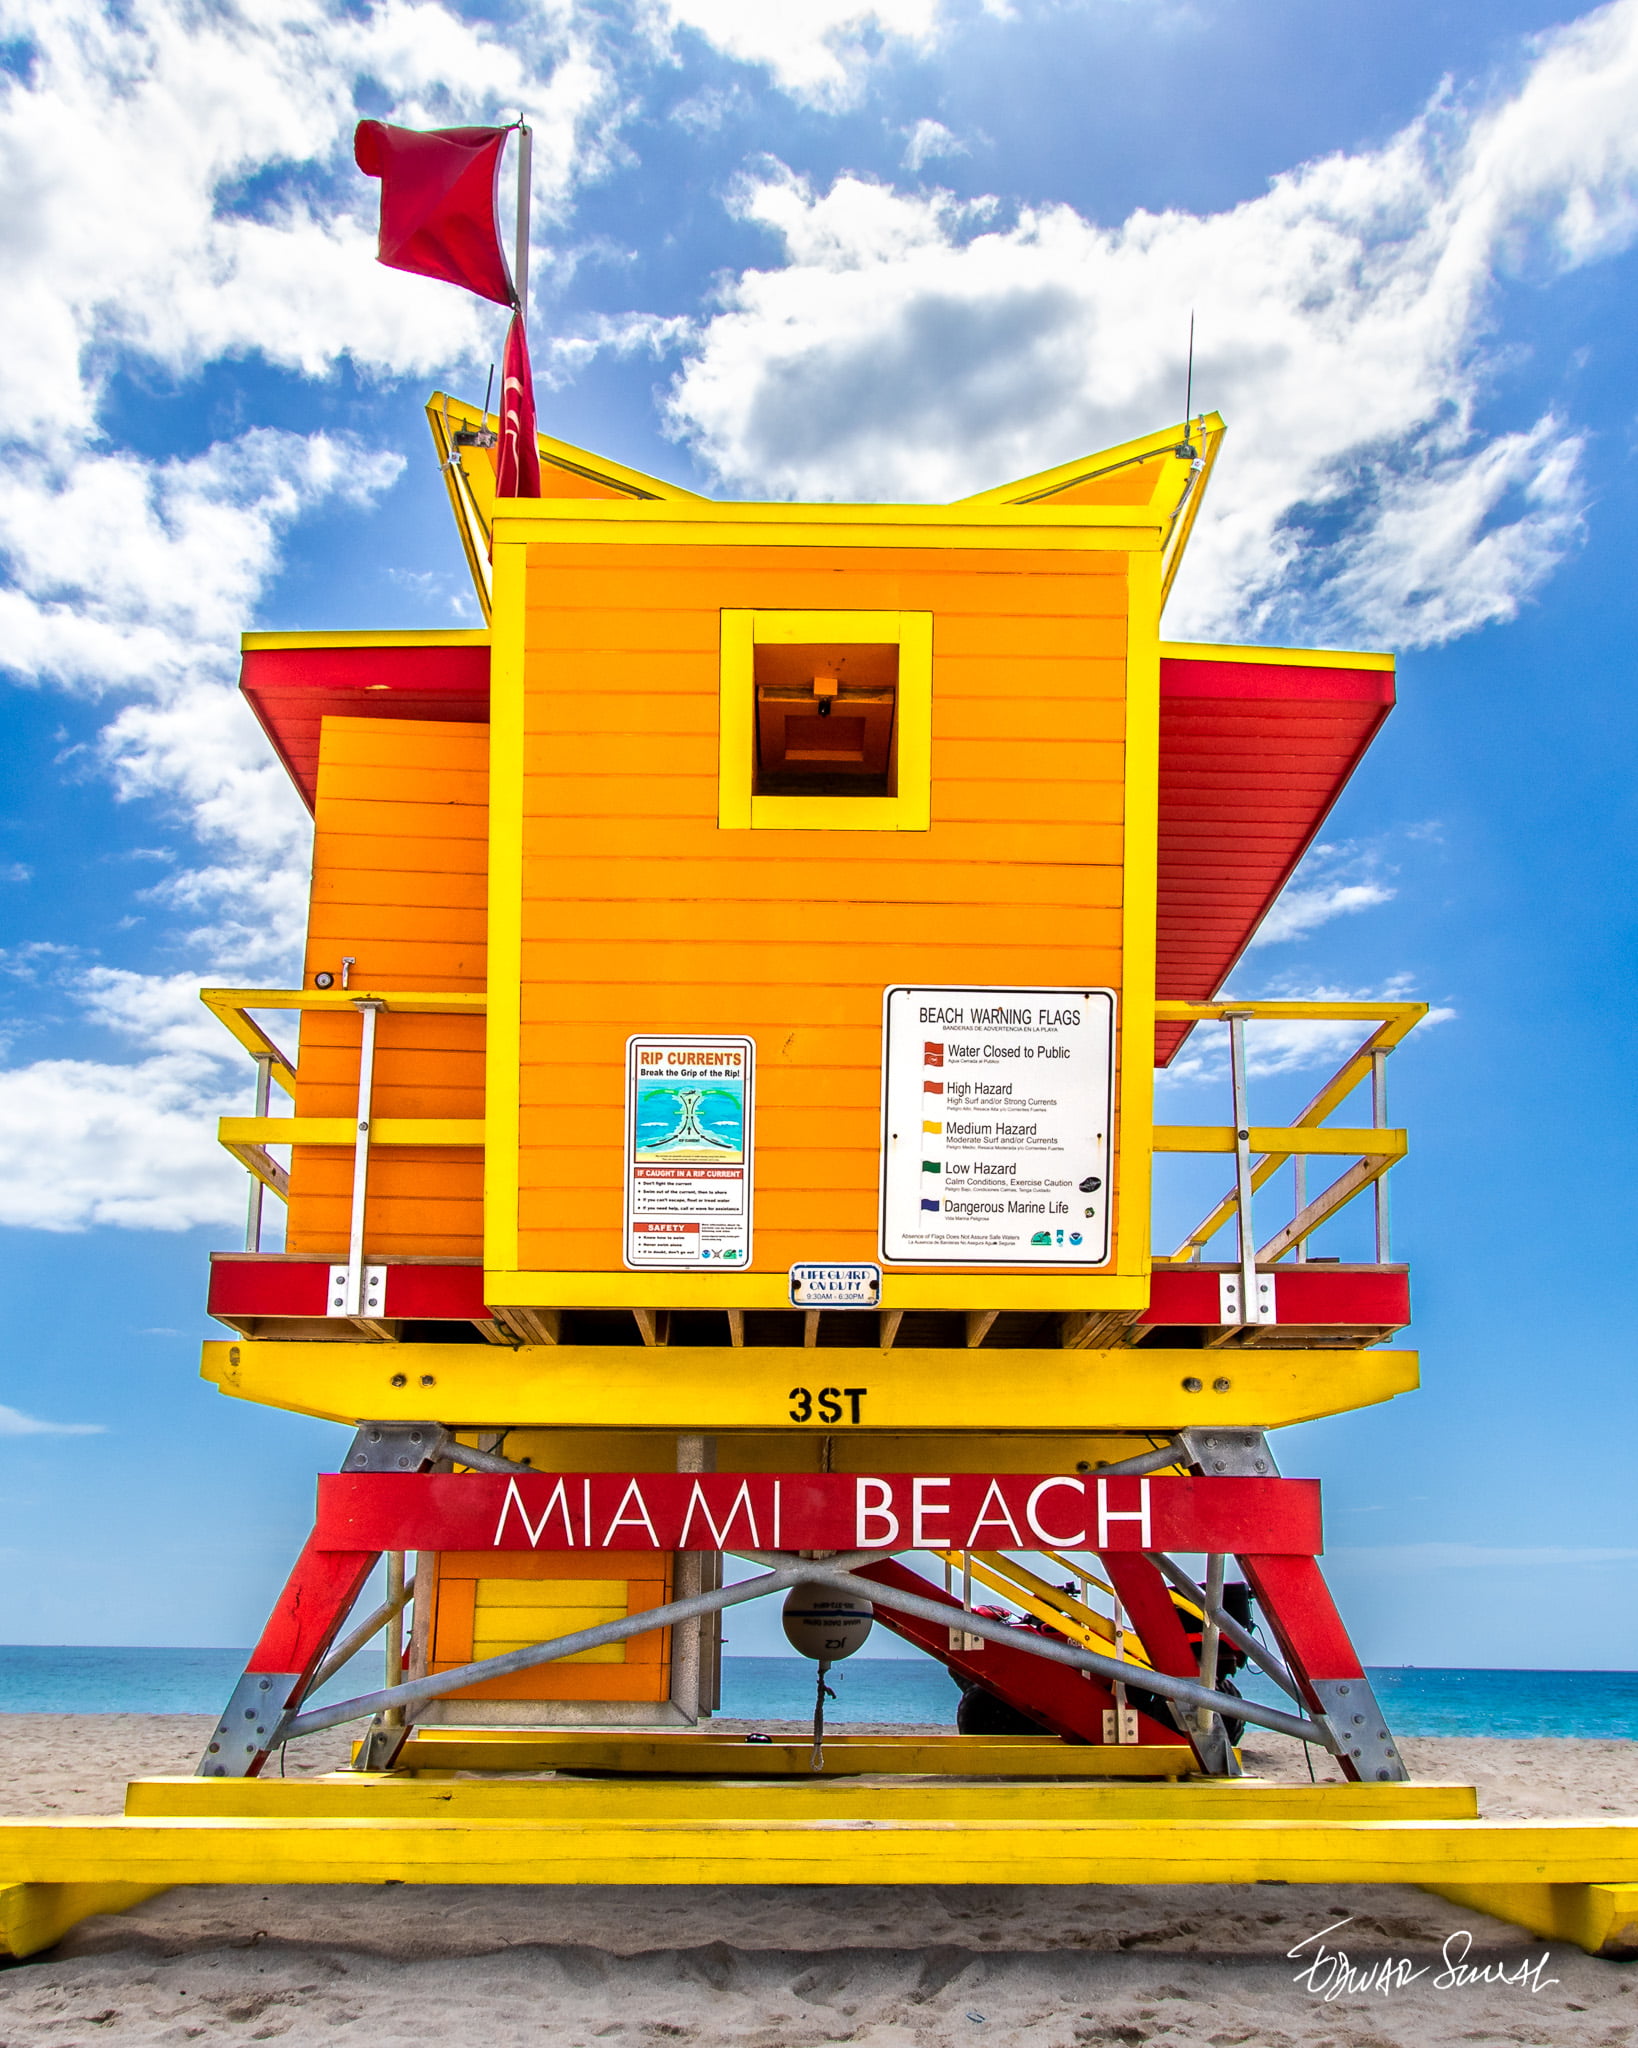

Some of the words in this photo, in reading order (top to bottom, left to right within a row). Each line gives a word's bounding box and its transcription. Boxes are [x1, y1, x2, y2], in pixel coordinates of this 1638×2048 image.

[920, 1008, 963, 1023] BEACH
[970, 1008, 1032, 1024] WARNING
[1039, 1009, 1080, 1025] FLAGS
[948, 1044, 980, 1057] Water
[983, 1045, 1020, 1057] Closed
[1024, 1046, 1034, 1058] to
[1038, 1046, 1070, 1059] Public
[641, 1052, 663, 1065] RIP
[668, 1052, 741, 1066] CURRENTS
[641, 1069, 663, 1077] Break
[666, 1069, 679, 1077] the
[681, 1069, 697, 1078] Grip
[700, 1069, 707, 1077] of
[725, 1070, 740, 1079] Rip!
[947, 1082, 971, 1097] High
[975, 1082, 1012, 1095] Hazard
[947, 1097, 963, 1105] High
[1003, 1098, 1026, 1106] Strong
[1028, 1098, 1057, 1106] Currents
[946, 1122, 992, 1135] Medium
[996, 1122, 1037, 1135] Hazard
[946, 1136, 981, 1144] Moderate
[983, 1136, 999, 1144] Surf
[945, 1162, 970, 1175] Low
[974, 1162, 1016, 1175] Hazard
[967, 1178, 1008, 1186] Conditions,
[945, 1200, 1004, 1216] Dangerous
[1008, 1201, 1045, 1214] Marine
[1048, 1201, 1069, 1214] Life
[810, 1281, 826, 1291] ON
[830, 1281, 861, 1291] DUTY
[493, 1476, 780, 1549] MIAMI
[855, 1476, 1151, 1549] BEACH
